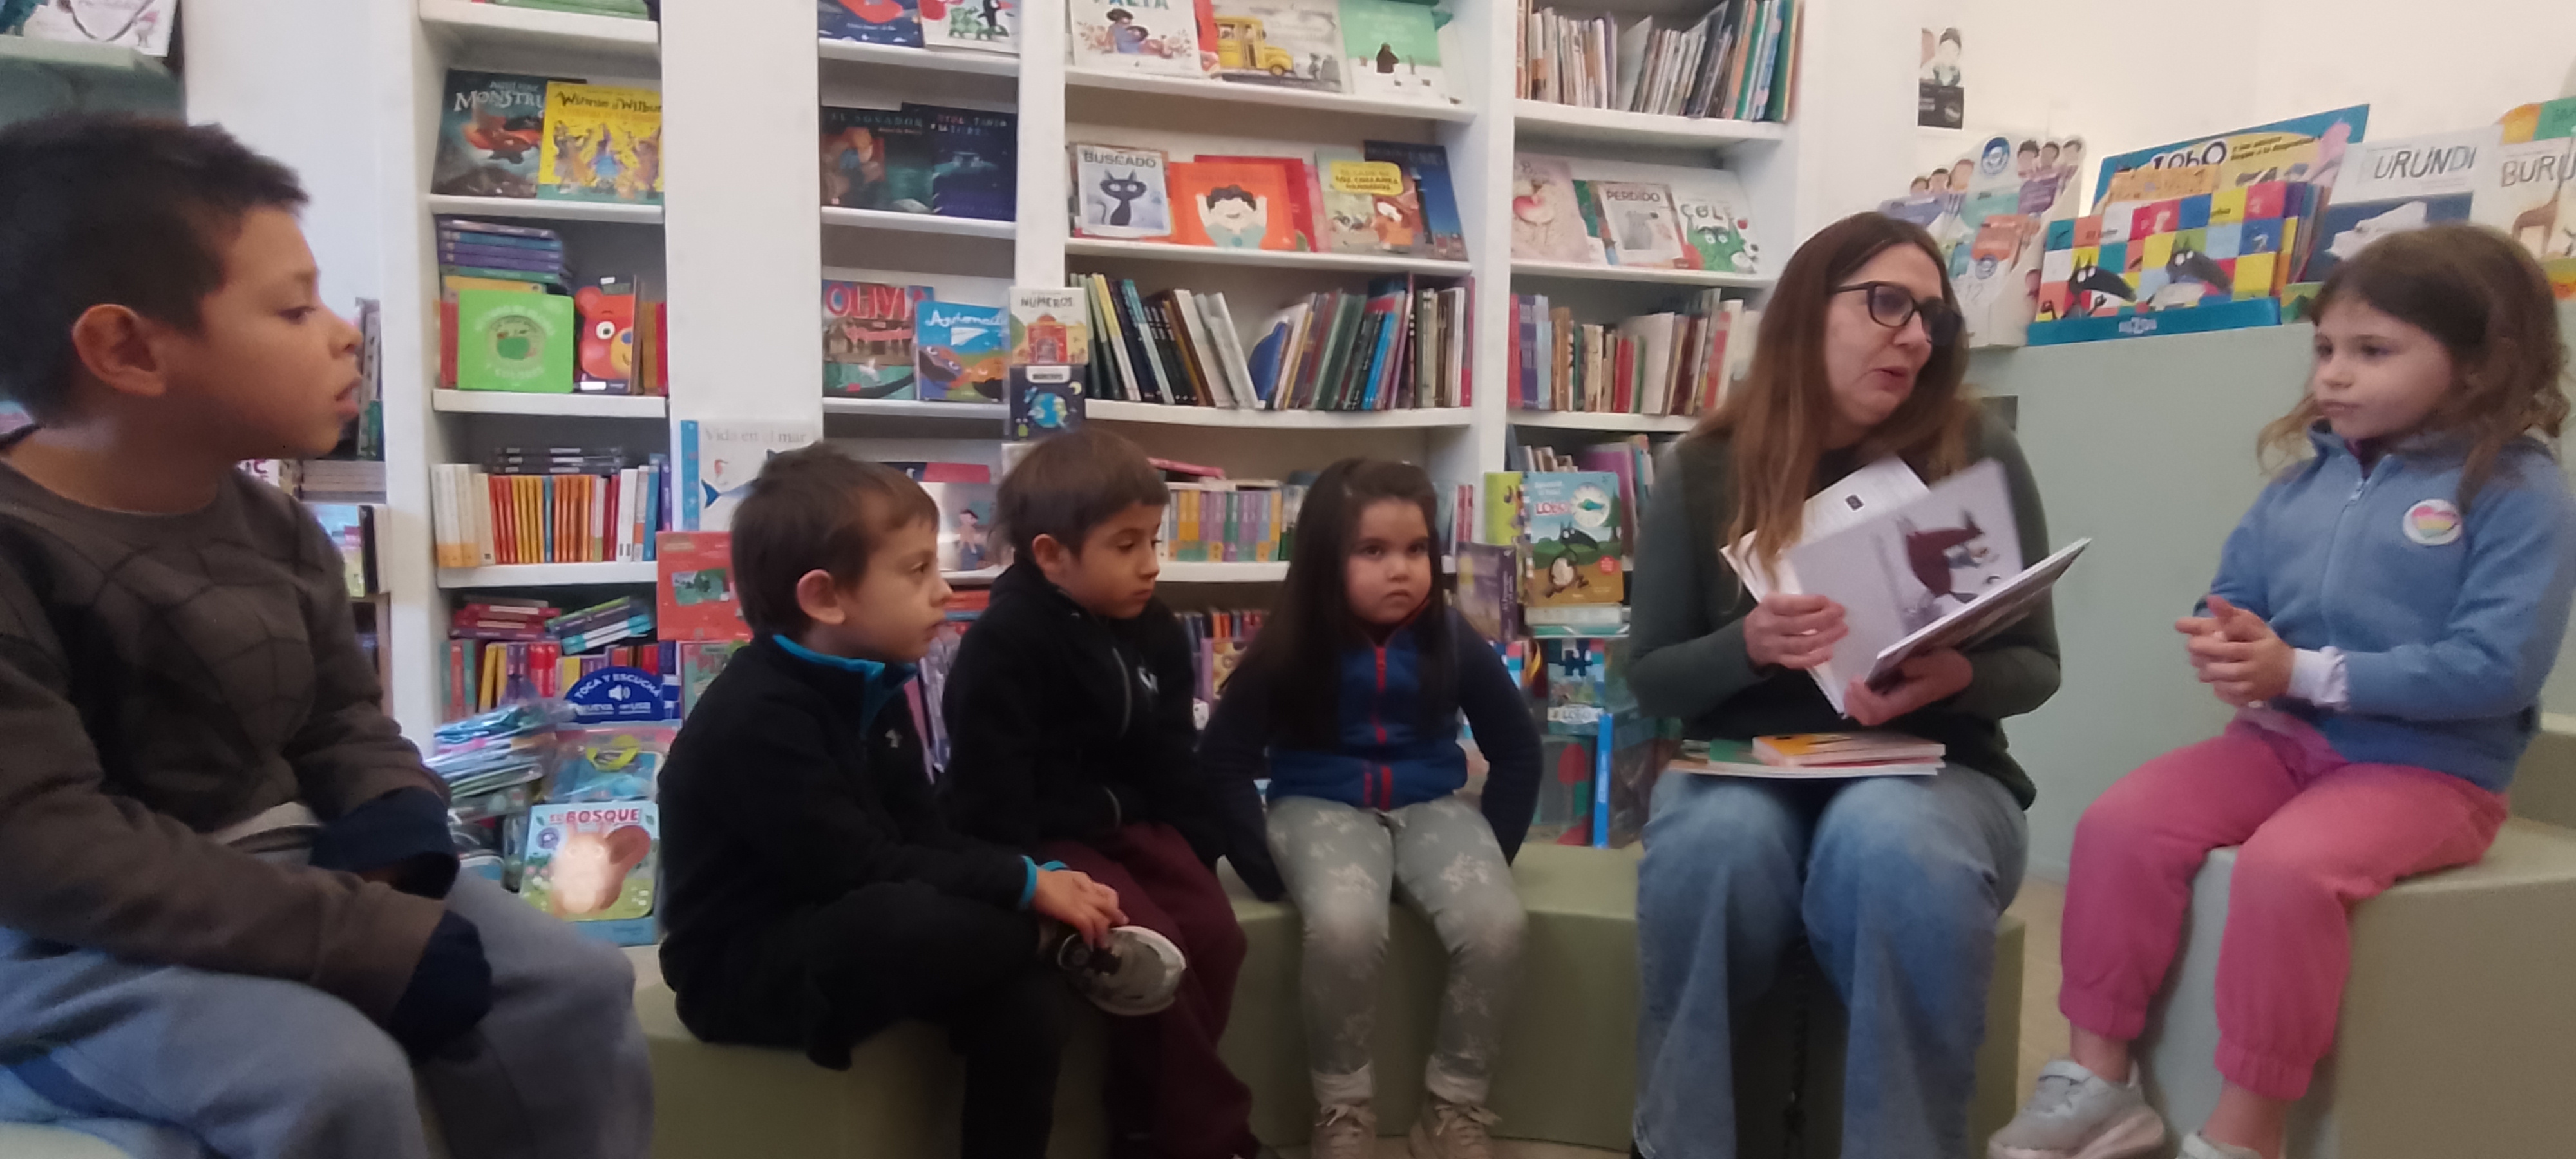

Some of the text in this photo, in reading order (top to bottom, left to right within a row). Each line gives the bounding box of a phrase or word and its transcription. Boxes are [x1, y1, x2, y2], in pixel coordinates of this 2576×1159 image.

[1083, 149, 1157, 168] BUSCADO
[2359, 146, 2476, 182] URUNDI
[1606, 191, 1661, 203] PERDIDO
[574, 673, 661, 699] TOCA Y ESCUCHA
[566, 808, 641, 824] BOSQUE
